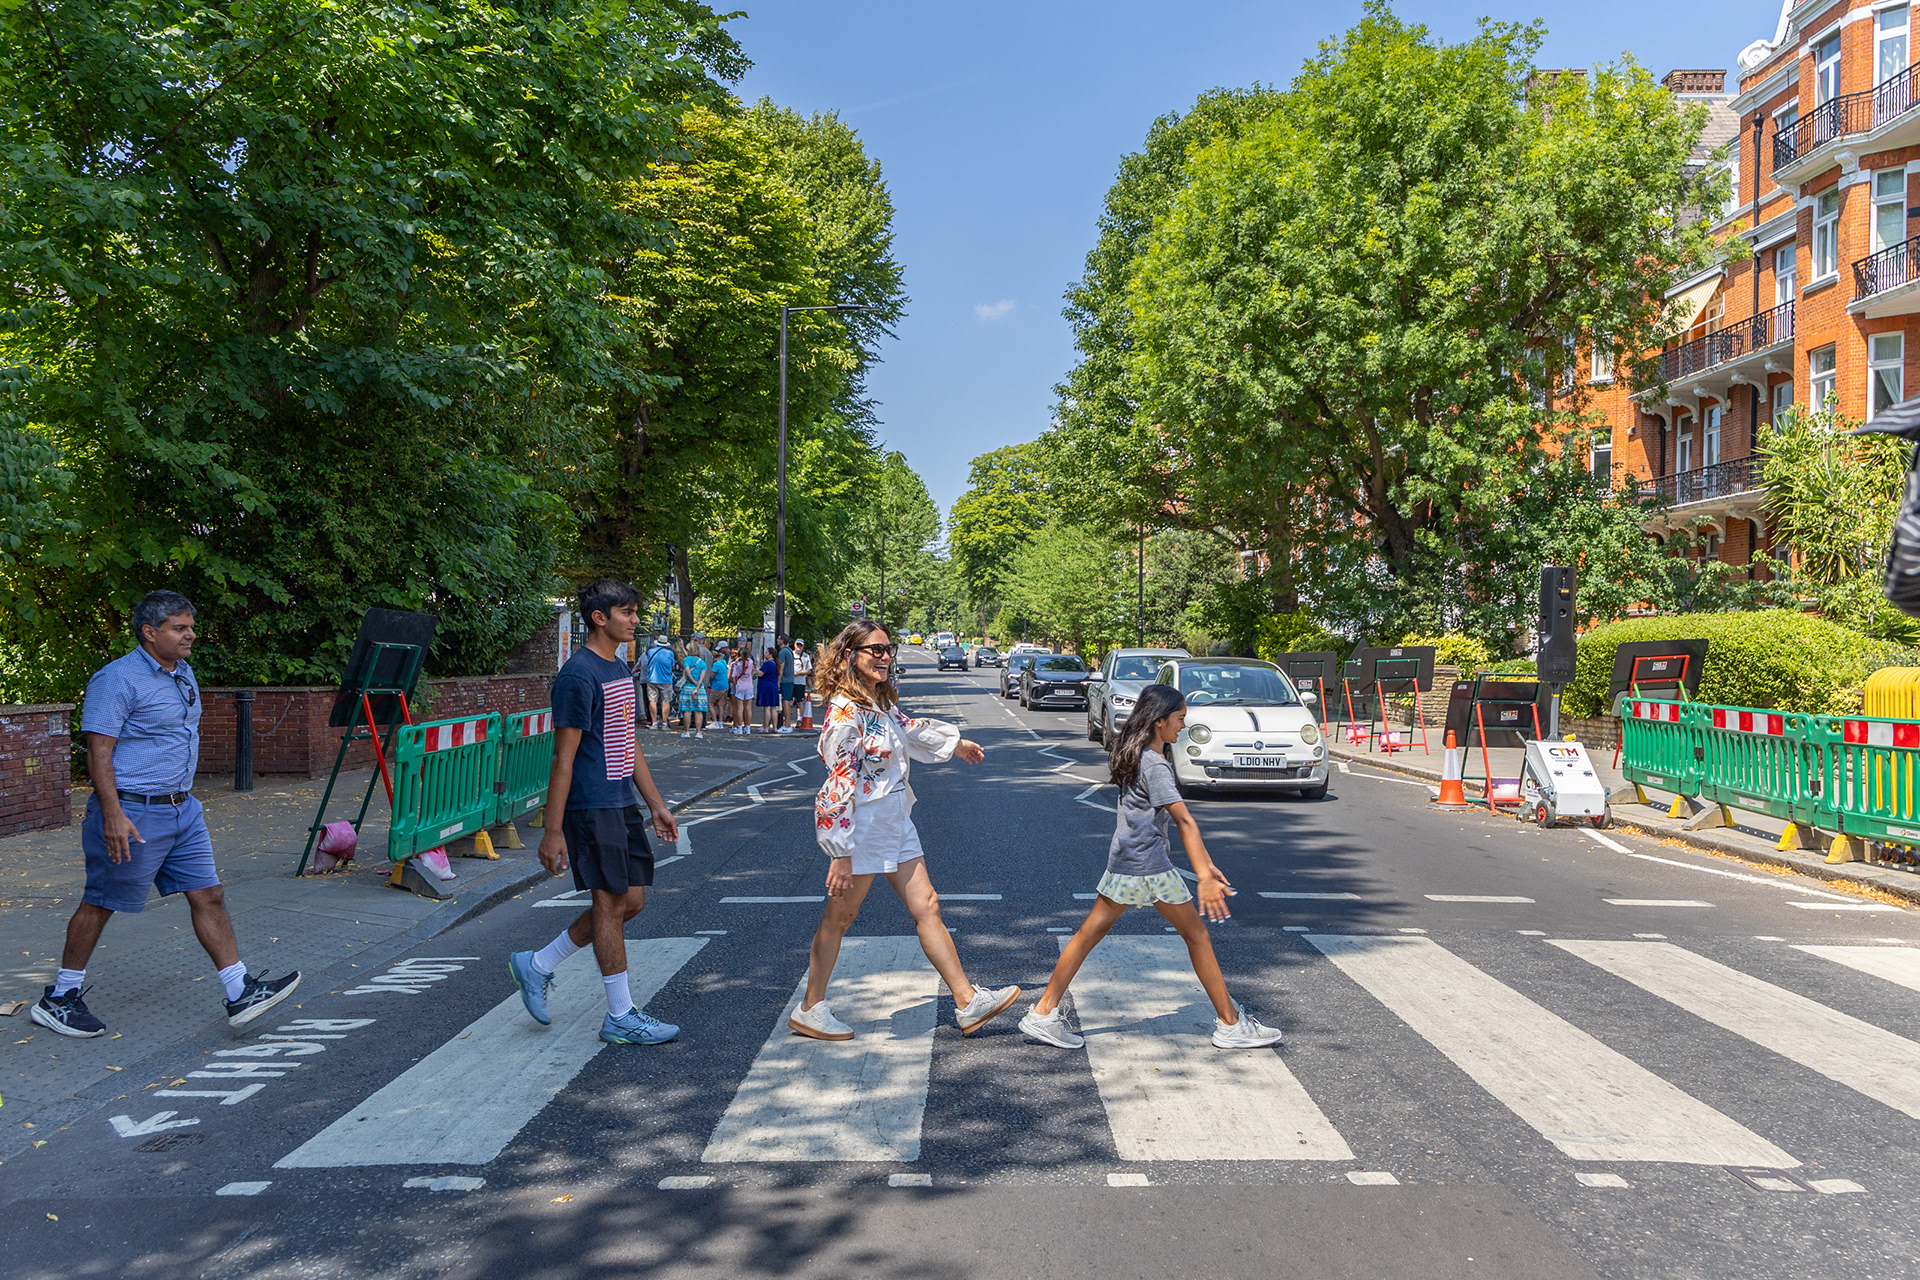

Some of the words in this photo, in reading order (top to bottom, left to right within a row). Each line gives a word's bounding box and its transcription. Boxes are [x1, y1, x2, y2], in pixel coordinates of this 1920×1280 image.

[1240, 757, 1260, 766] LD10
[1263, 757, 1280, 766] NHV
[1549, 748, 1579, 756] CTM
[343, 956, 481, 995] LOOK
[153, 1018, 377, 1105] RIGHT
